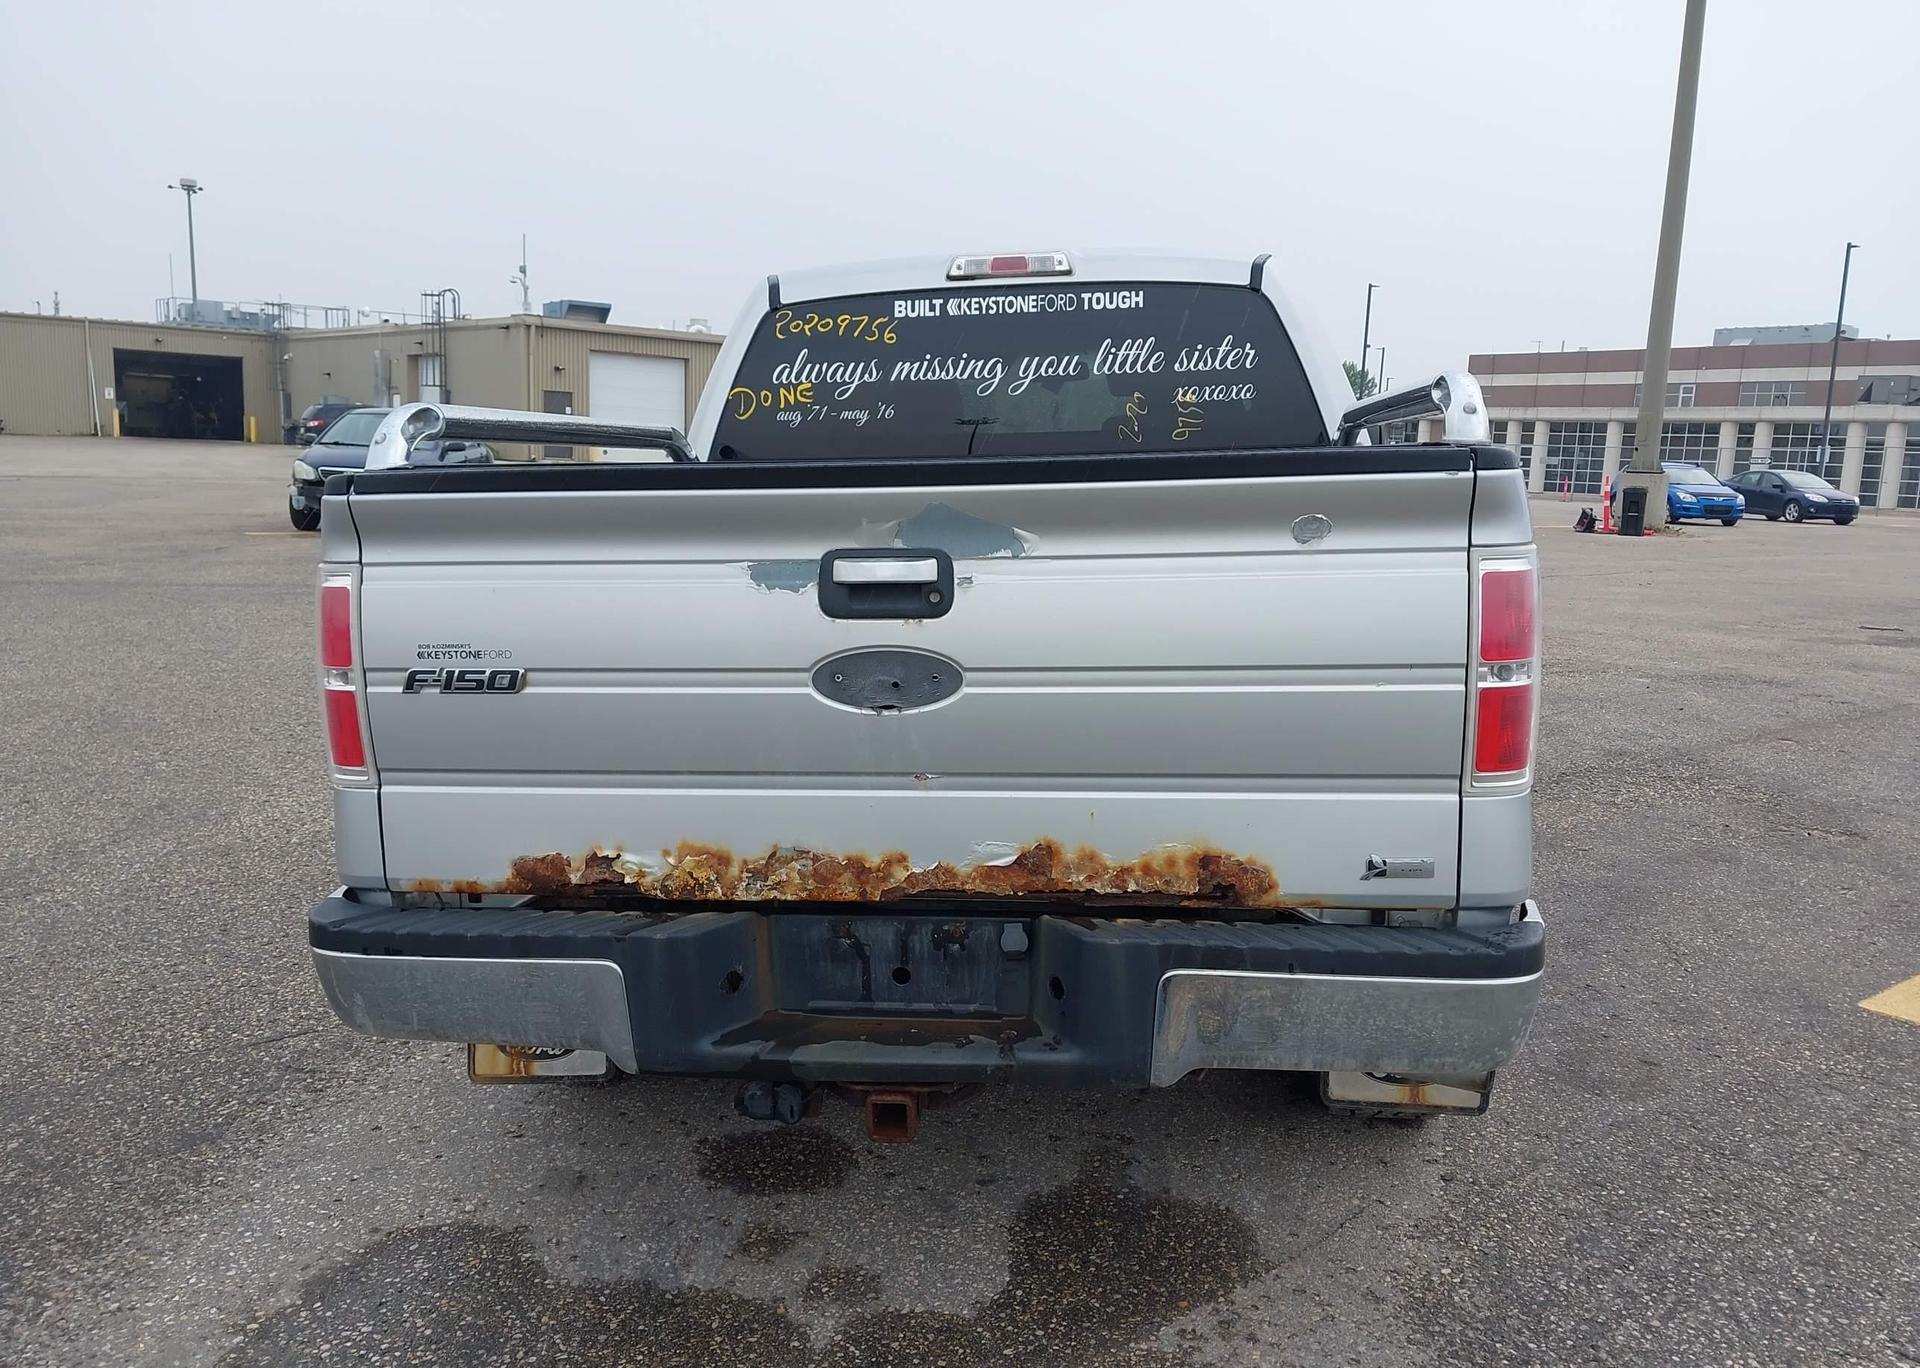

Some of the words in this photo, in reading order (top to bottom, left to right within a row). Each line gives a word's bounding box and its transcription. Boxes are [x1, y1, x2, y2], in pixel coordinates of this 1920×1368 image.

[894, 299, 943, 318] BUILT
[1081, 290, 1144, 311] TOUGH
[775, 310, 898, 344] 20209756
[772, 348, 882, 400] always
[890, 352, 1009, 397] missing
[1008, 353, 1082, 396] you
[1093, 336, 1166, 376] little
[1173, 334, 1259, 373] sister
[729, 383, 816, 420] DONE
[1171, 383, 1257, 404] xoxoxo
[776, 409, 803, 428] aug
[840, 408, 871, 427] may
[876, 401, 895, 419] '16
[427, 649, 513, 660] KEYSTONEFORD
[402, 667, 527, 694] F-150
